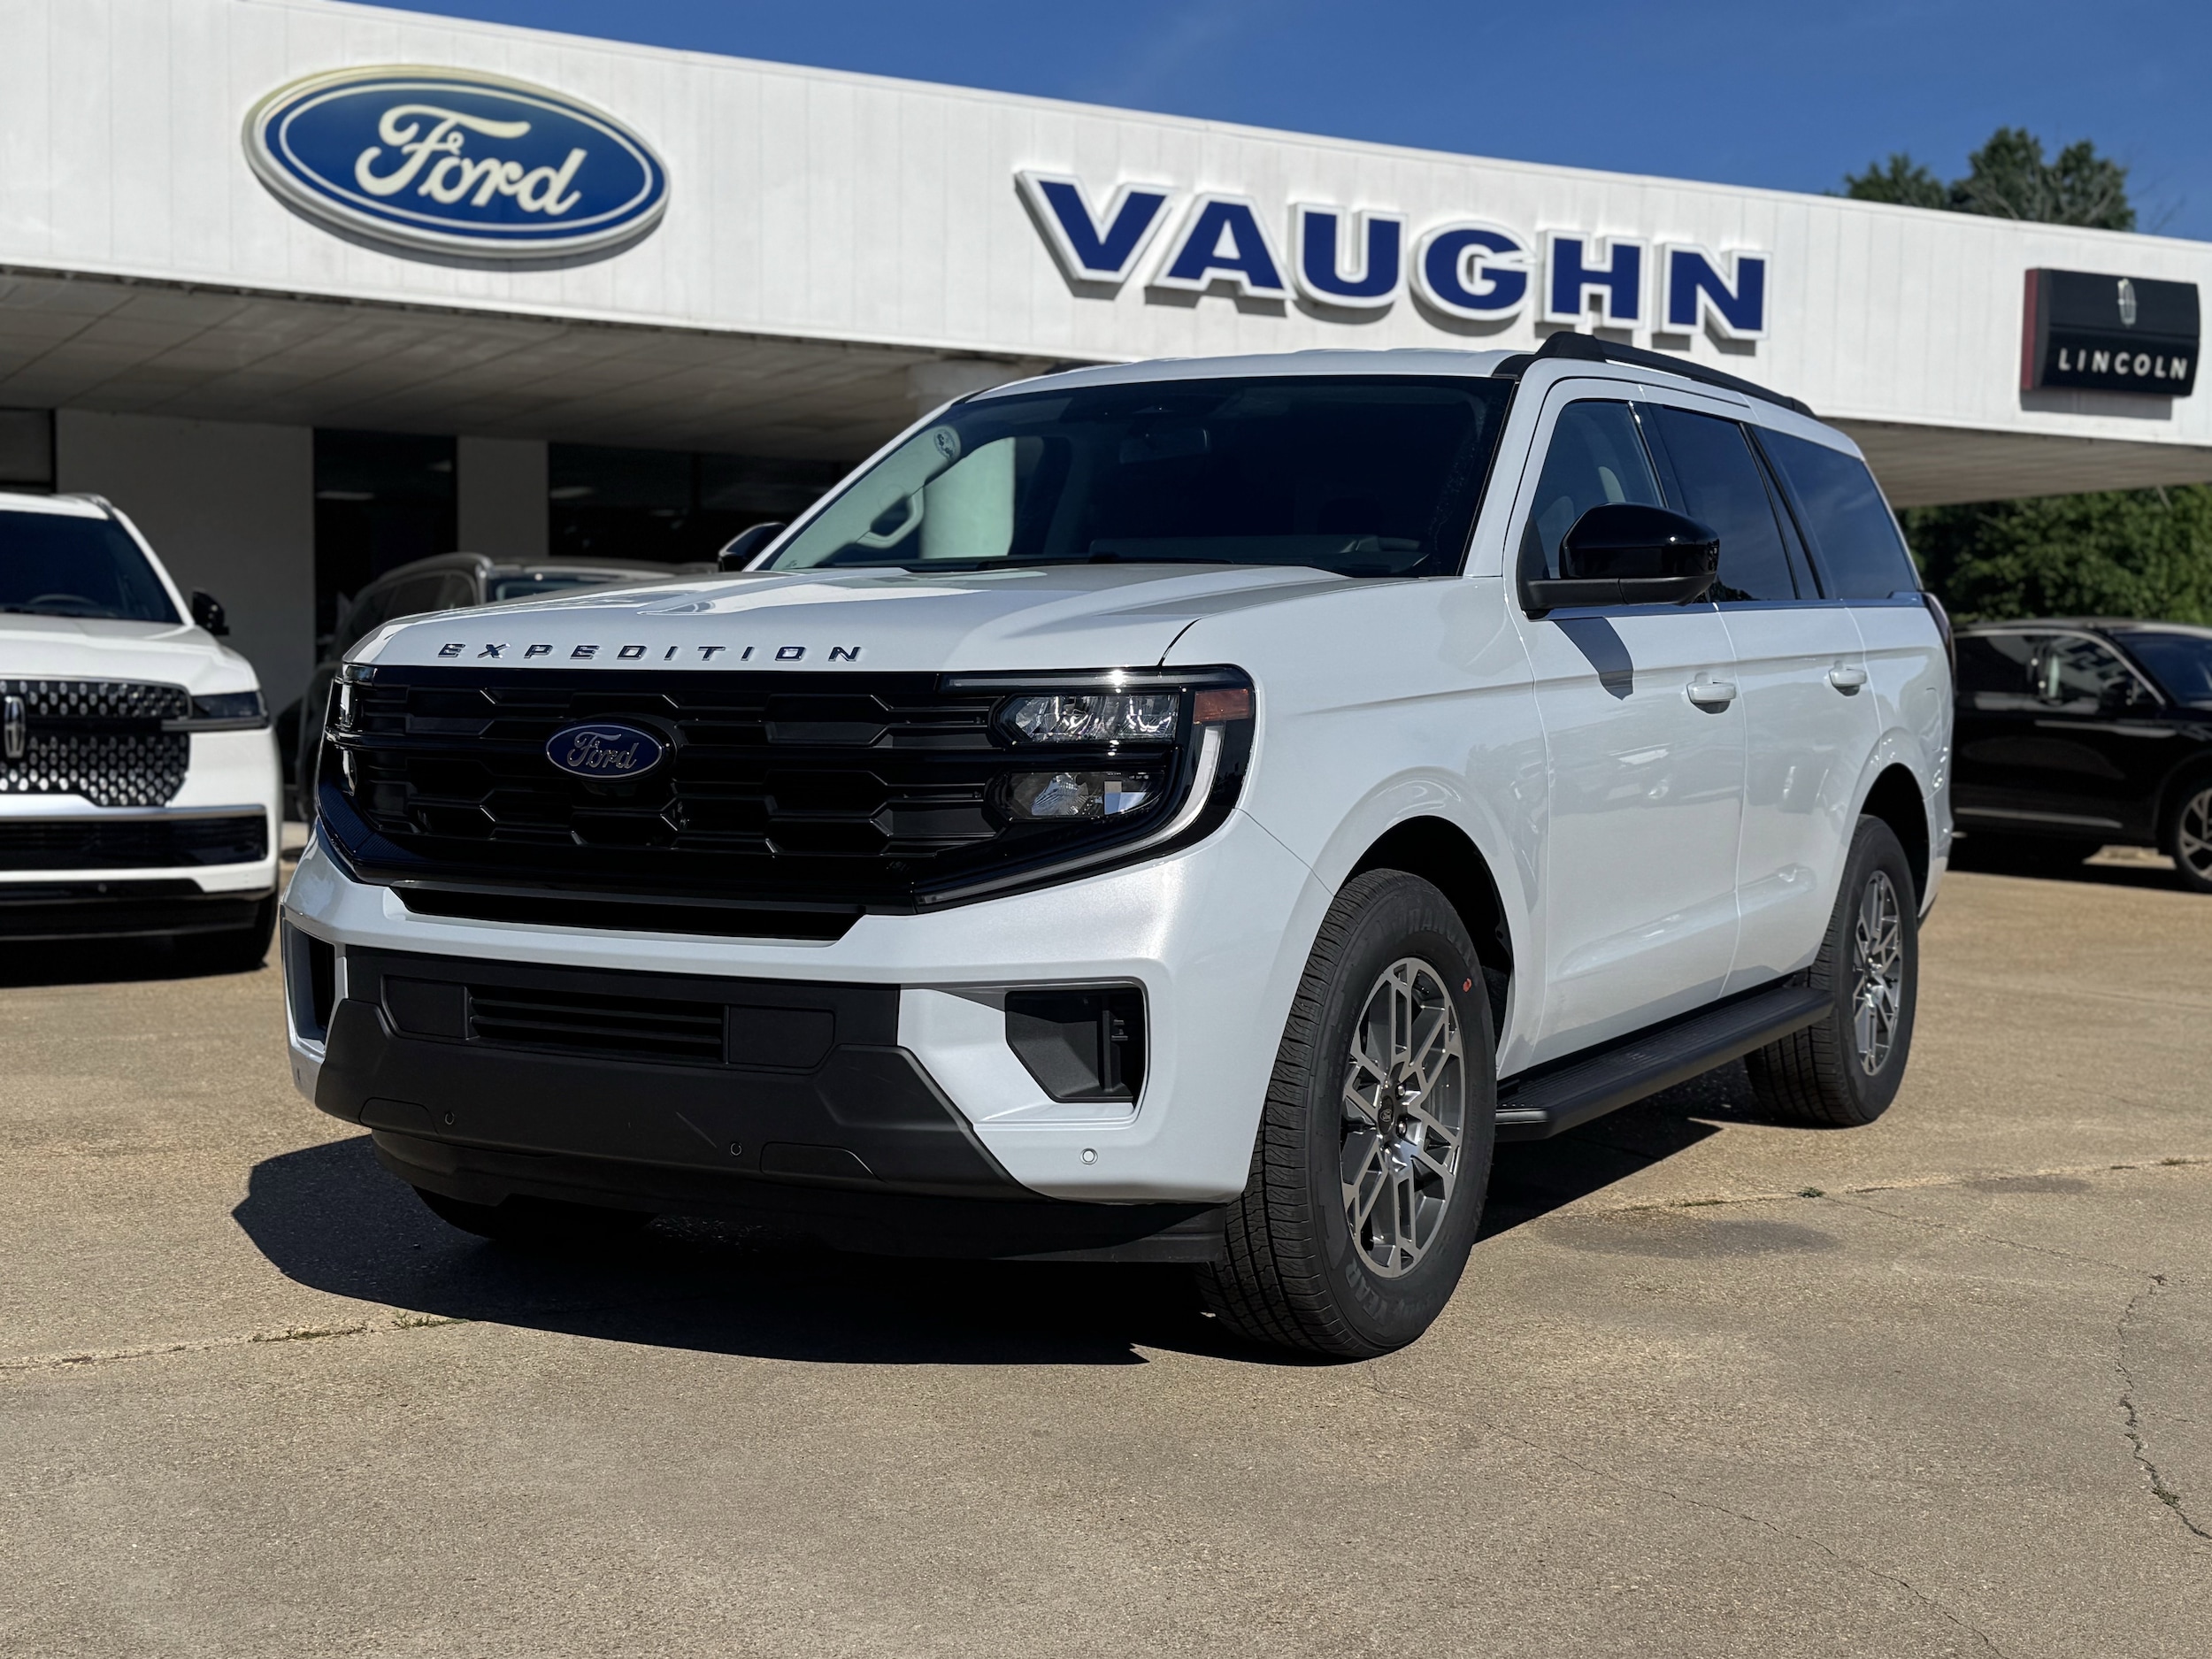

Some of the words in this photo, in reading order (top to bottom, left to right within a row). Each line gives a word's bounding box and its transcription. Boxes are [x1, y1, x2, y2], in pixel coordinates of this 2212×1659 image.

[354, 104, 588, 216] Ford
[1023, 171, 1772, 340] VAUGHN
[2058, 348, 2188, 380] LINCOLN
[437, 643, 863, 662] EXPEDITION
[566, 731, 640, 770] Ford
